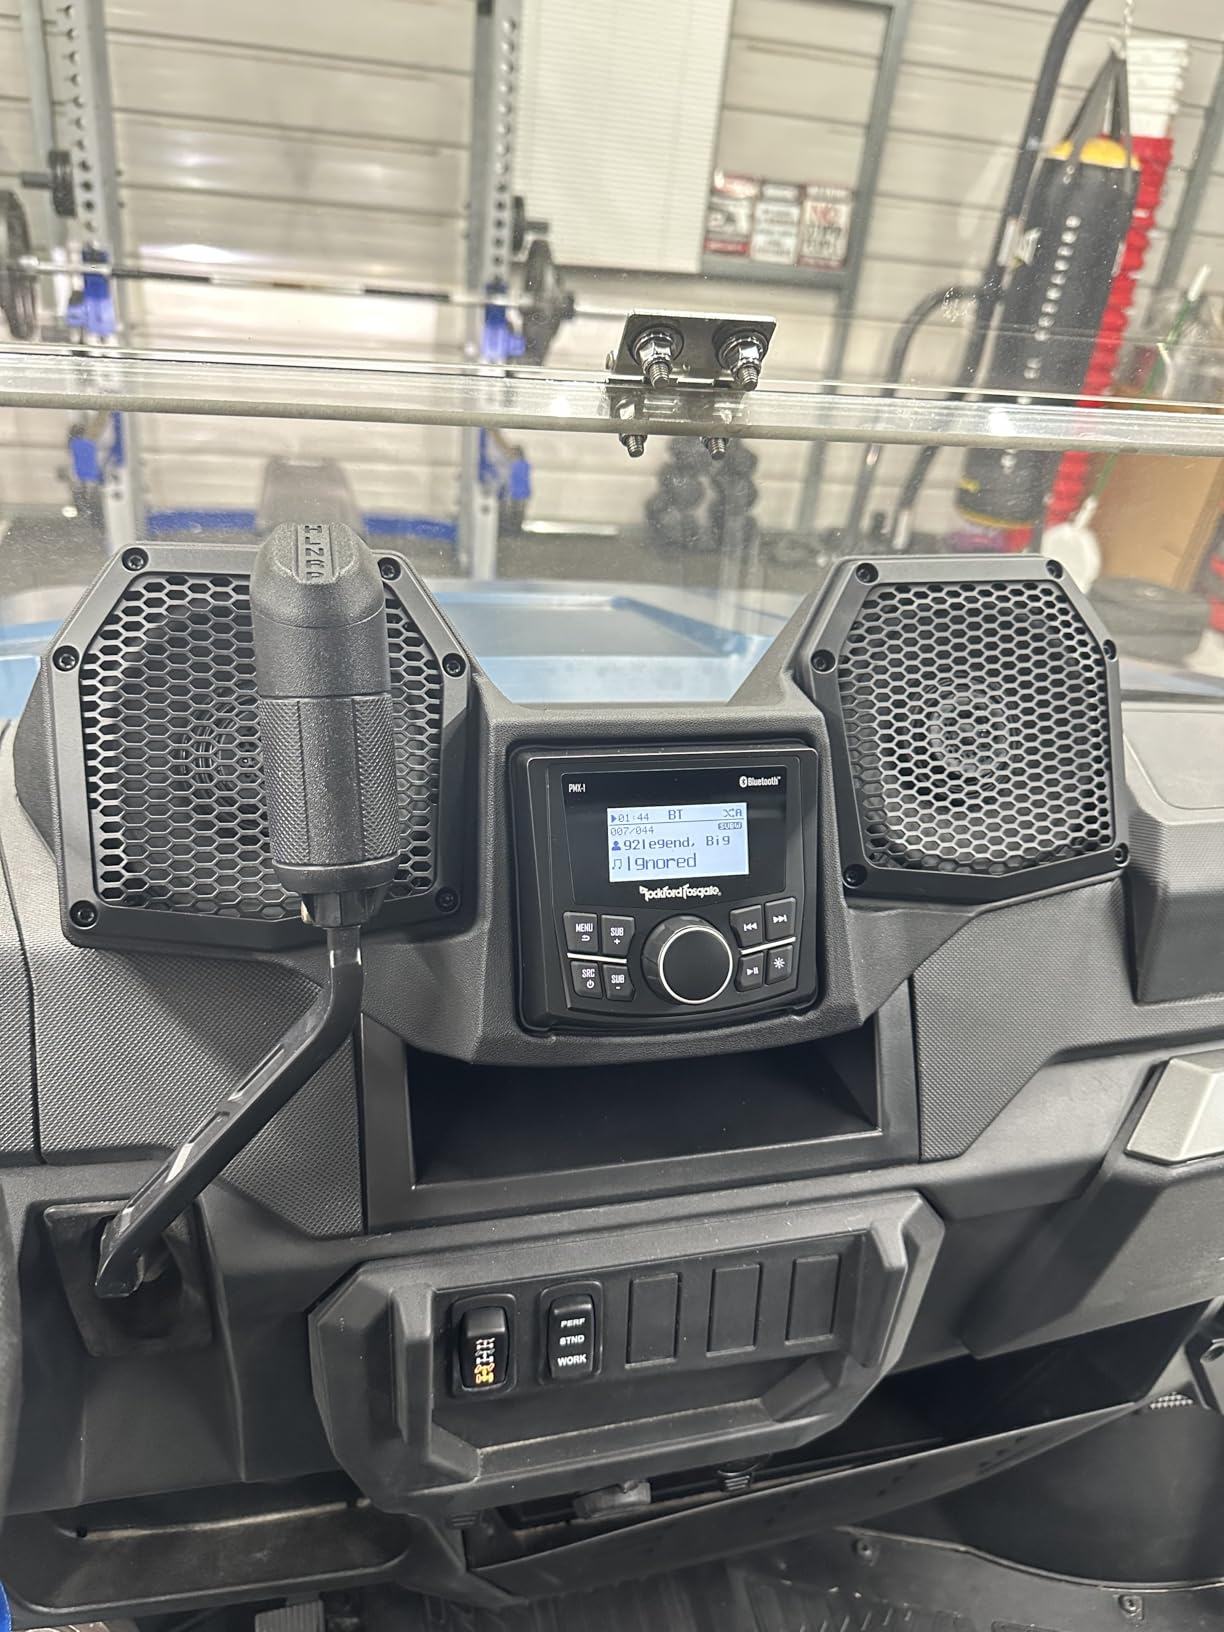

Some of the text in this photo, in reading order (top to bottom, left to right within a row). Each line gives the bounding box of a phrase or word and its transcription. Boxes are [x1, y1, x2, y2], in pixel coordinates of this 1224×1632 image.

[568, 783, 586, 793] PMX-1
[618, 813, 649, 822] 01:44
[668, 809, 684, 820] BT
[610, 825, 654, 836] 007/044
[706, 834, 730, 846] Big
[575, 923, 593, 933] MENU
[610, 927, 624, 937] SUB
[582, 968, 596, 978] SRC
[611, 974, 625, 984] SUB
[561, 1318, 585, 1327] PERF
[560, 1335, 584, 1345] STND
[557, 1354, 586, 1366] WORK
